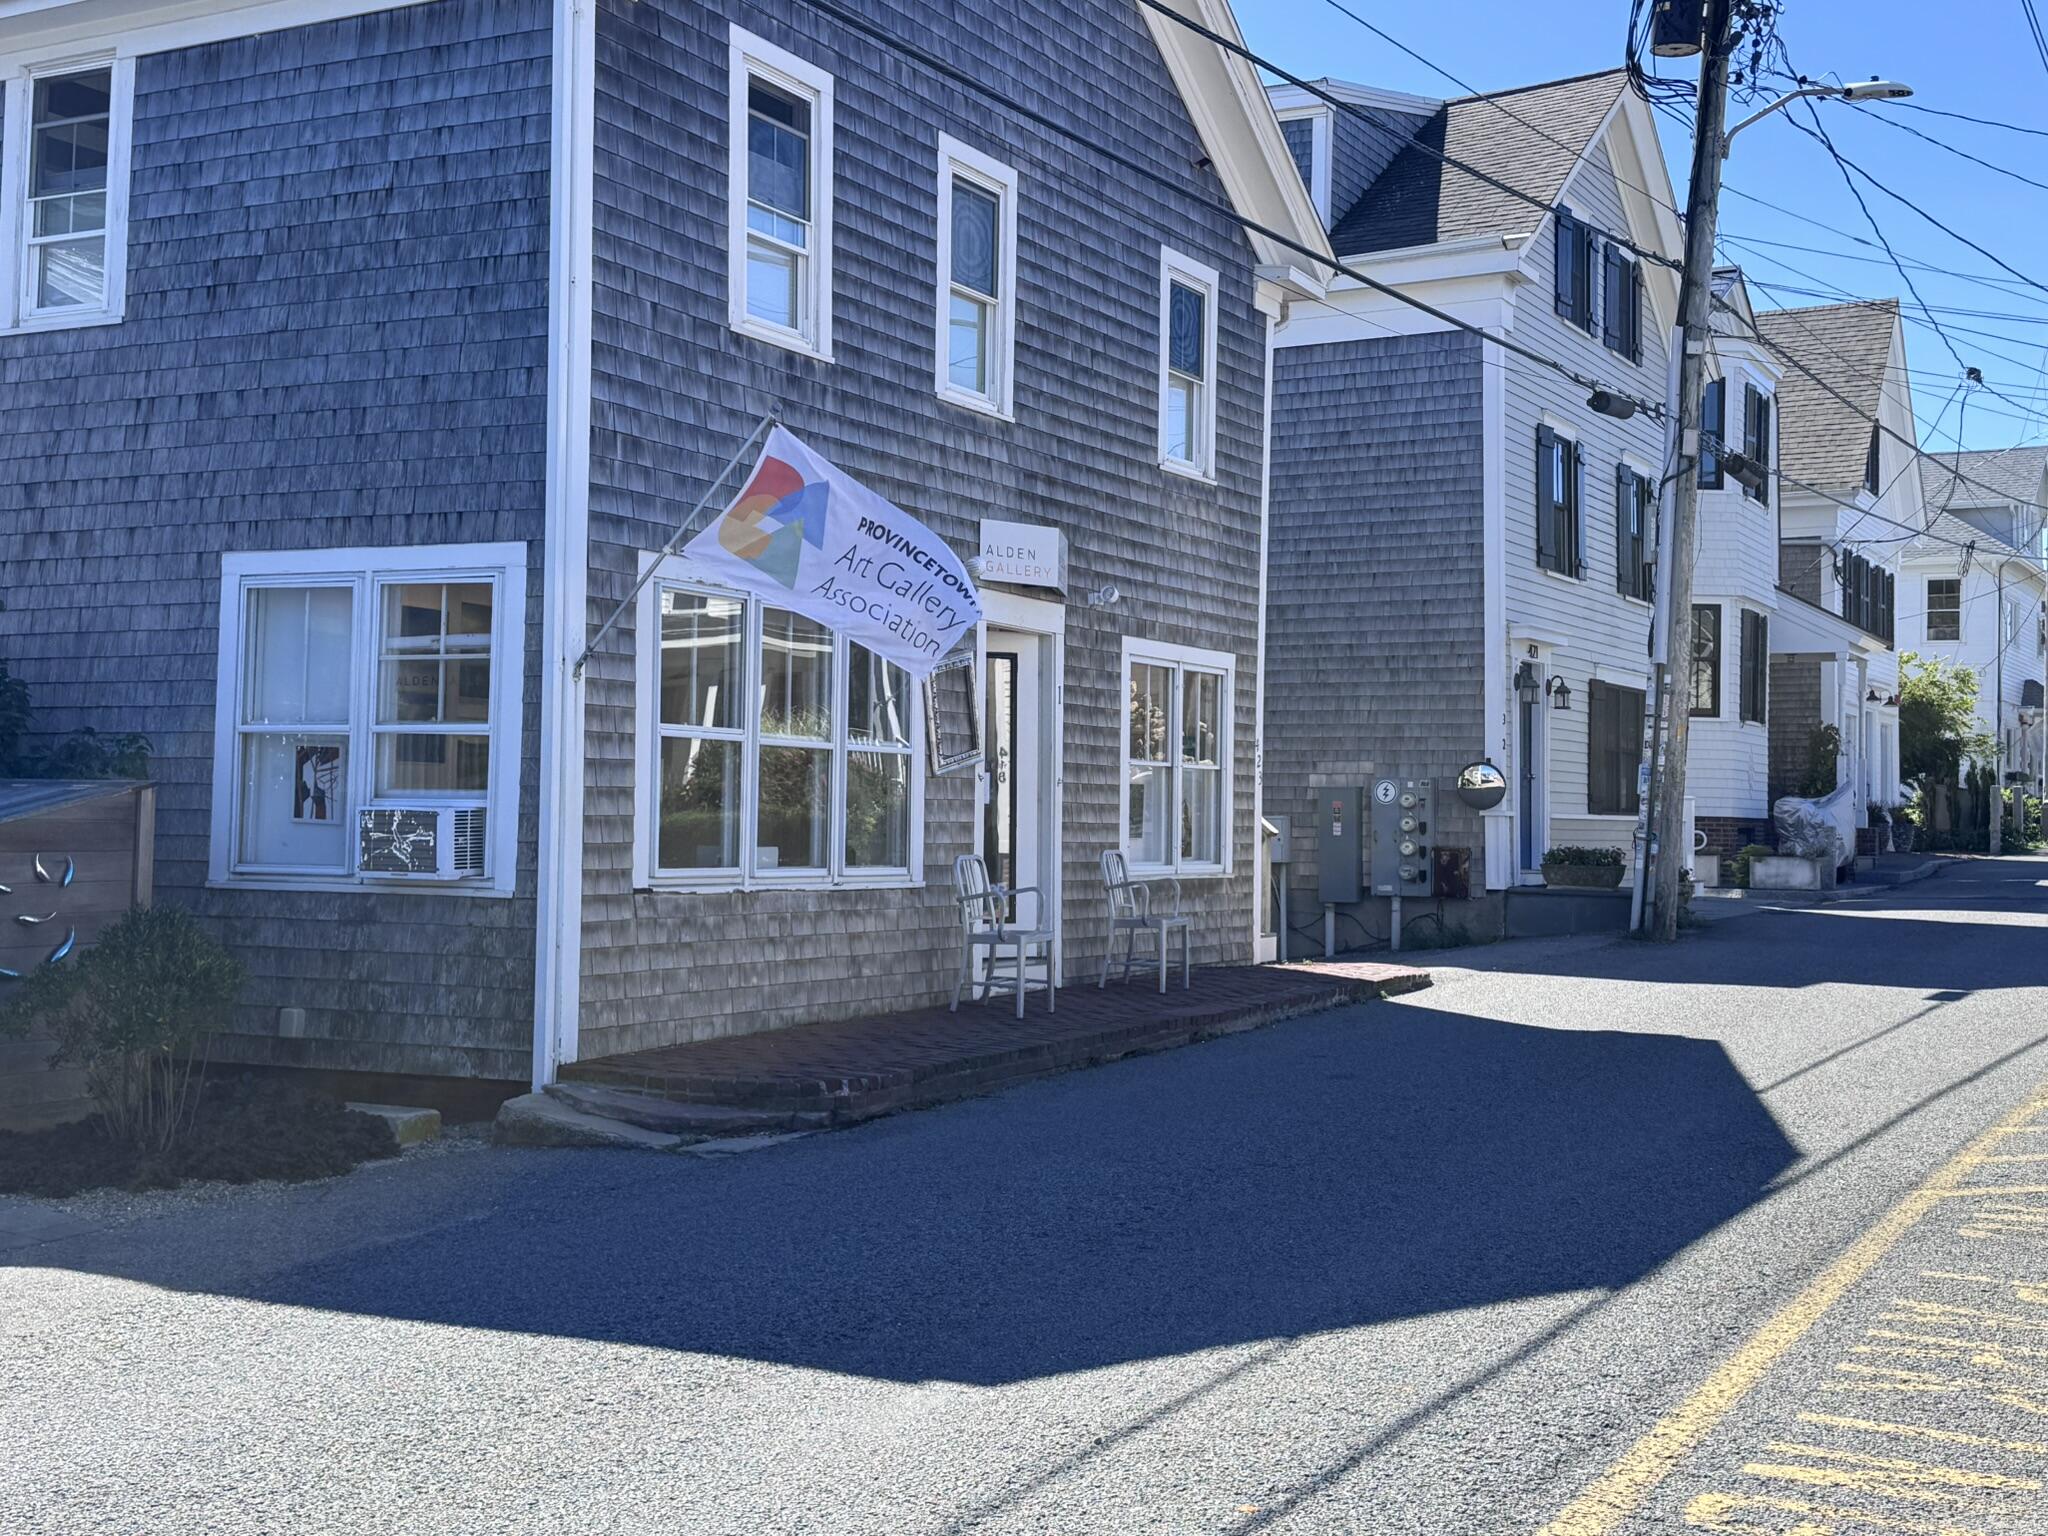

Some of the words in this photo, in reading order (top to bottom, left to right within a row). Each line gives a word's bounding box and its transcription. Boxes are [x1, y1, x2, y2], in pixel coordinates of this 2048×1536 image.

[986, 544, 1036, 560] ALDEN
[986, 560, 1052, 579] GALLERY
[834, 544, 874, 578] Art
[877, 562, 967, 631] Gallery
[810, 576, 940, 657] Association
